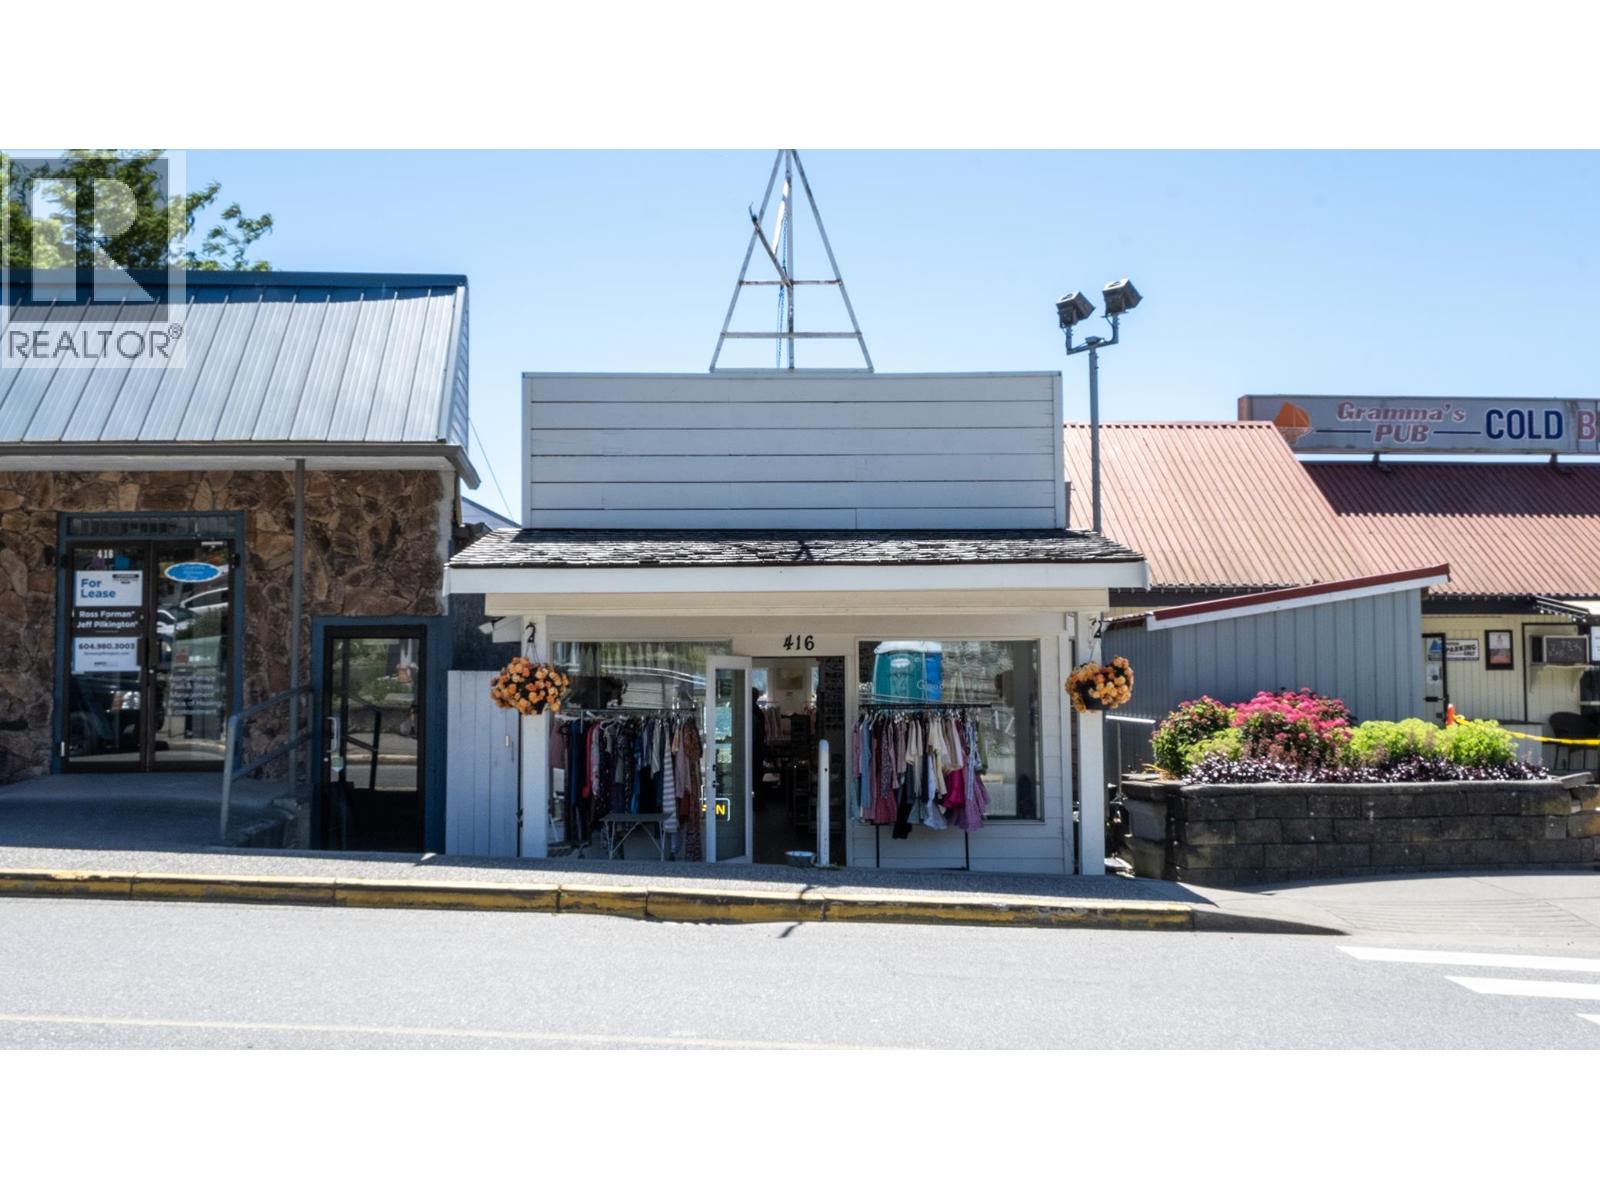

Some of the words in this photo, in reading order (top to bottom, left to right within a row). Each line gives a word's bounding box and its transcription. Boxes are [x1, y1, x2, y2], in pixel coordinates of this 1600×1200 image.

[1336, 401, 1466, 422] Gramma's
[1485, 409, 1564, 440] COLD
[1577, 410, 1600, 441] B
[1373, 422, 1430, 443] PUB
[96, 549, 114, 559] 418
[80, 578, 102, 588] For
[80, 588, 117, 599] Lease
[76, 621, 93, 629] Jeff
[783, 634, 815, 651] 416
